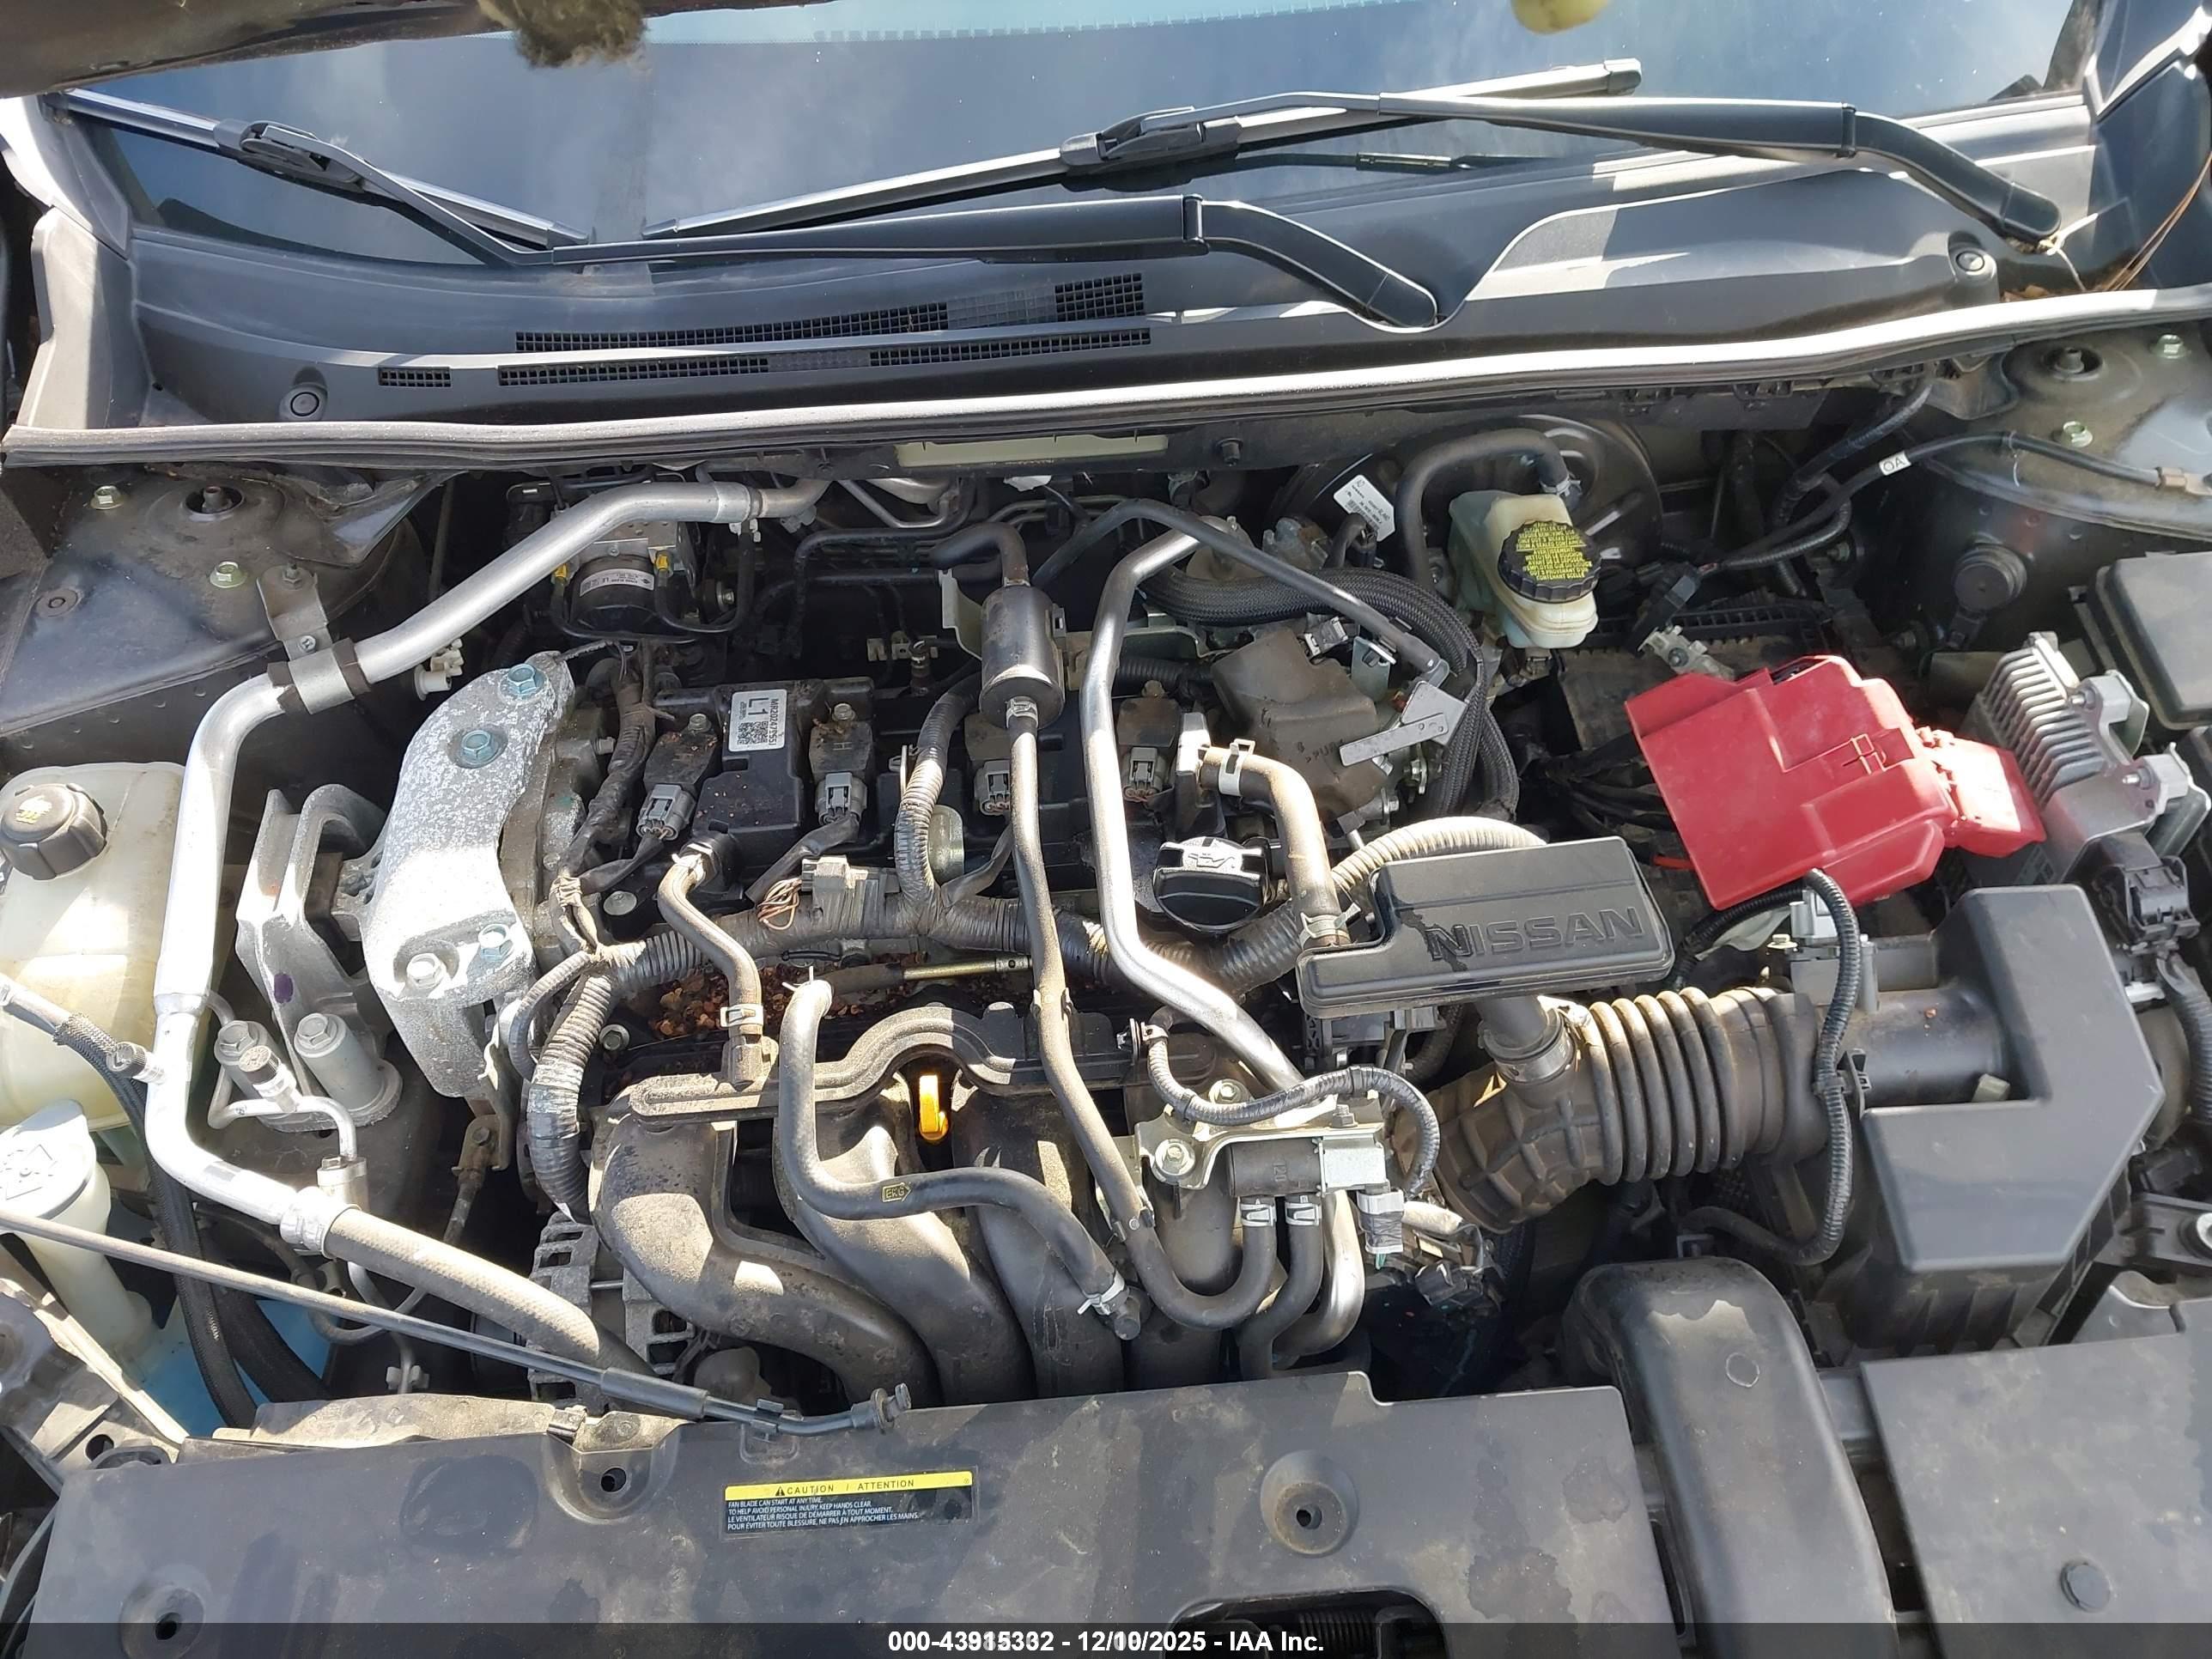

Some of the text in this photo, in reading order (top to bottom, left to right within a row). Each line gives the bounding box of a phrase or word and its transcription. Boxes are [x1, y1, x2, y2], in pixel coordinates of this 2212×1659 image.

[748, 697, 769, 715] L1
[1425, 907, 1644, 961] NISSAN
[787, 1485, 834, 1495] CAUTION
[858, 1480, 915, 1491] ATTENTION
[736, 1514, 775, 1522] VENTILATEUR
[849, 1515, 886, 1523] APPROCHER
